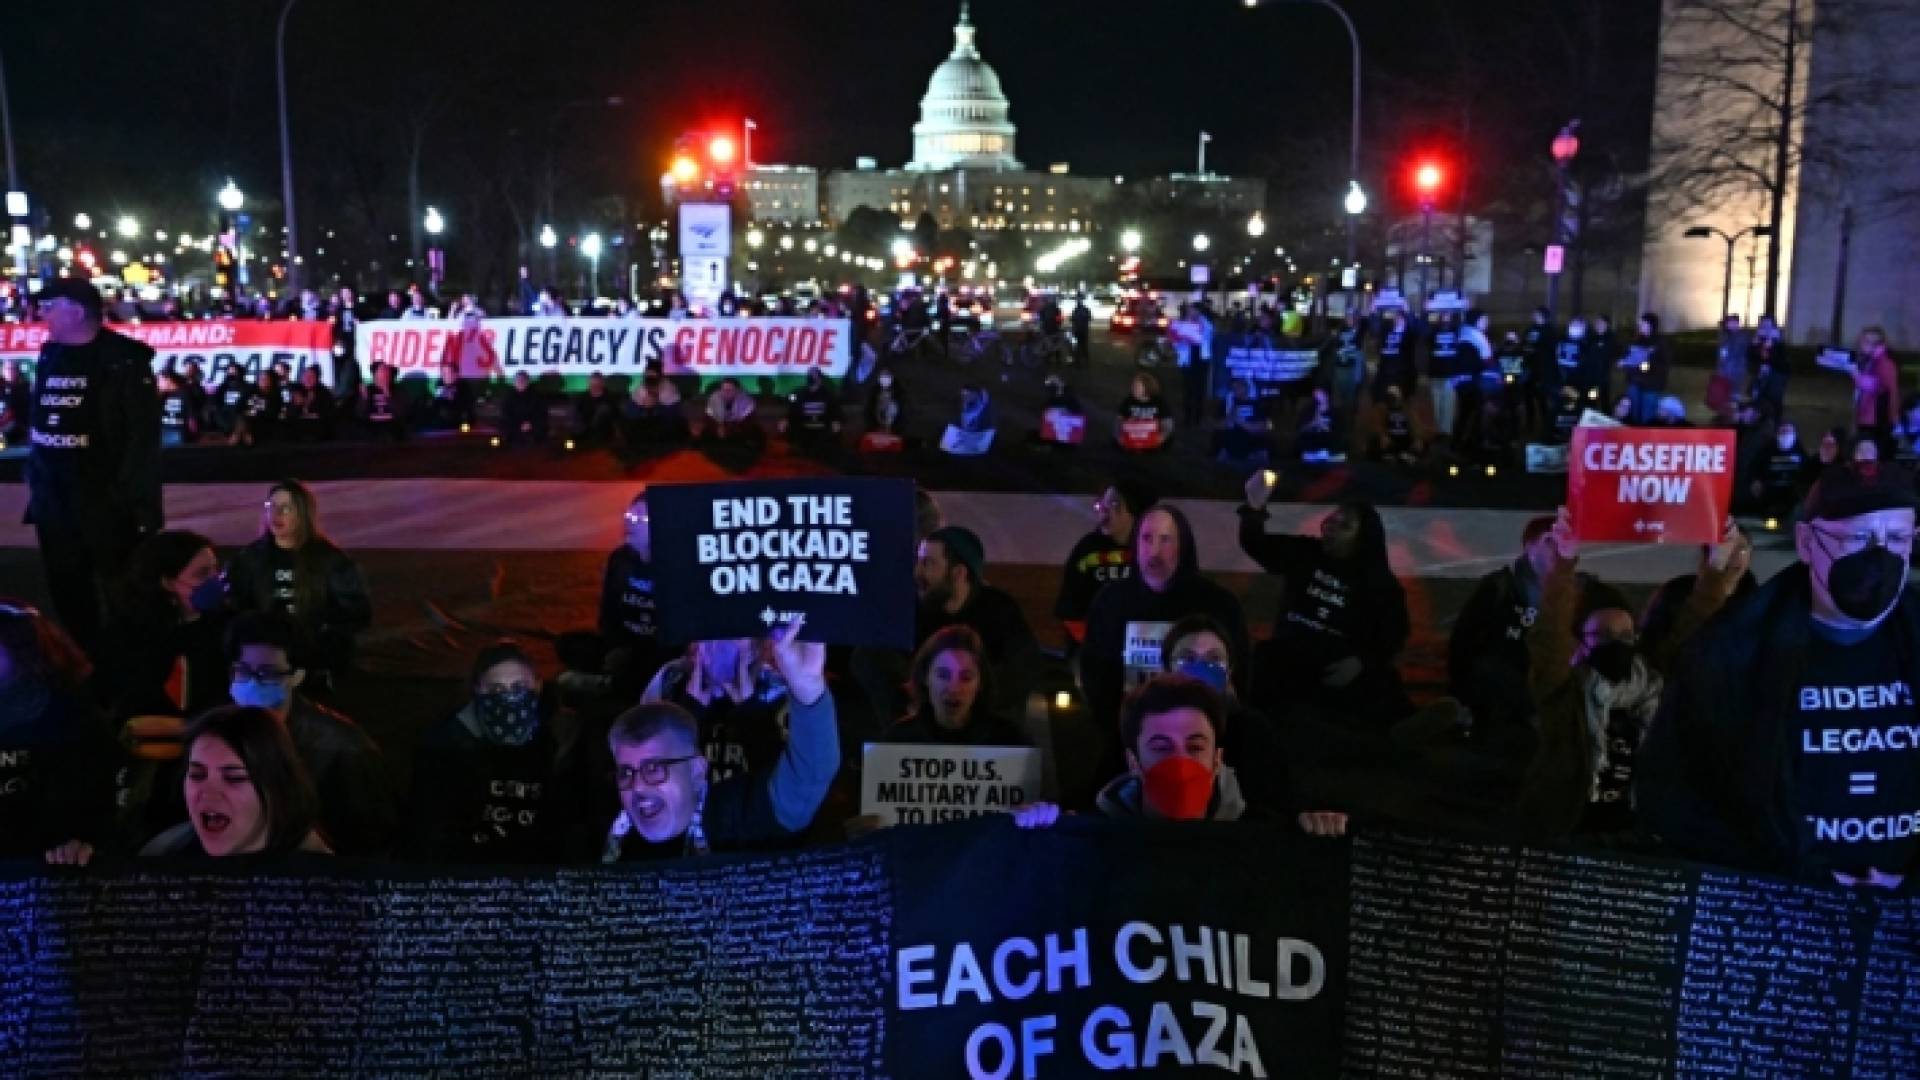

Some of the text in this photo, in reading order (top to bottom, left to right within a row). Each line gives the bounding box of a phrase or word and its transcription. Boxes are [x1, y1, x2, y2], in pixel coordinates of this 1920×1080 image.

[119, 325, 236, 344] EMAND:
[369, 326, 838, 368] BIDEN'S LEGACY IS GENOCIDE
[31, 426, 90, 448] NOCIDE
[1584, 442, 1727, 473] CEASEFIRE
[1617, 475, 1692, 504] NOW
[712, 496, 853, 529] END THE
[697, 529, 870, 564] BLOCKADE
[710, 563, 858, 595] ON GAZA
[1802, 725, 1920, 753] LEGACY
[900, 758, 1003, 781] STOP U.S.
[877, 782, 1025, 806] MILITARY AID
[895, 806, 924, 825] TO
[1806, 809, 1920, 842] NOCIDE
[896, 920, 1327, 1011] EACH CHILD
[964, 1000, 1268, 1080] OF GAZA
